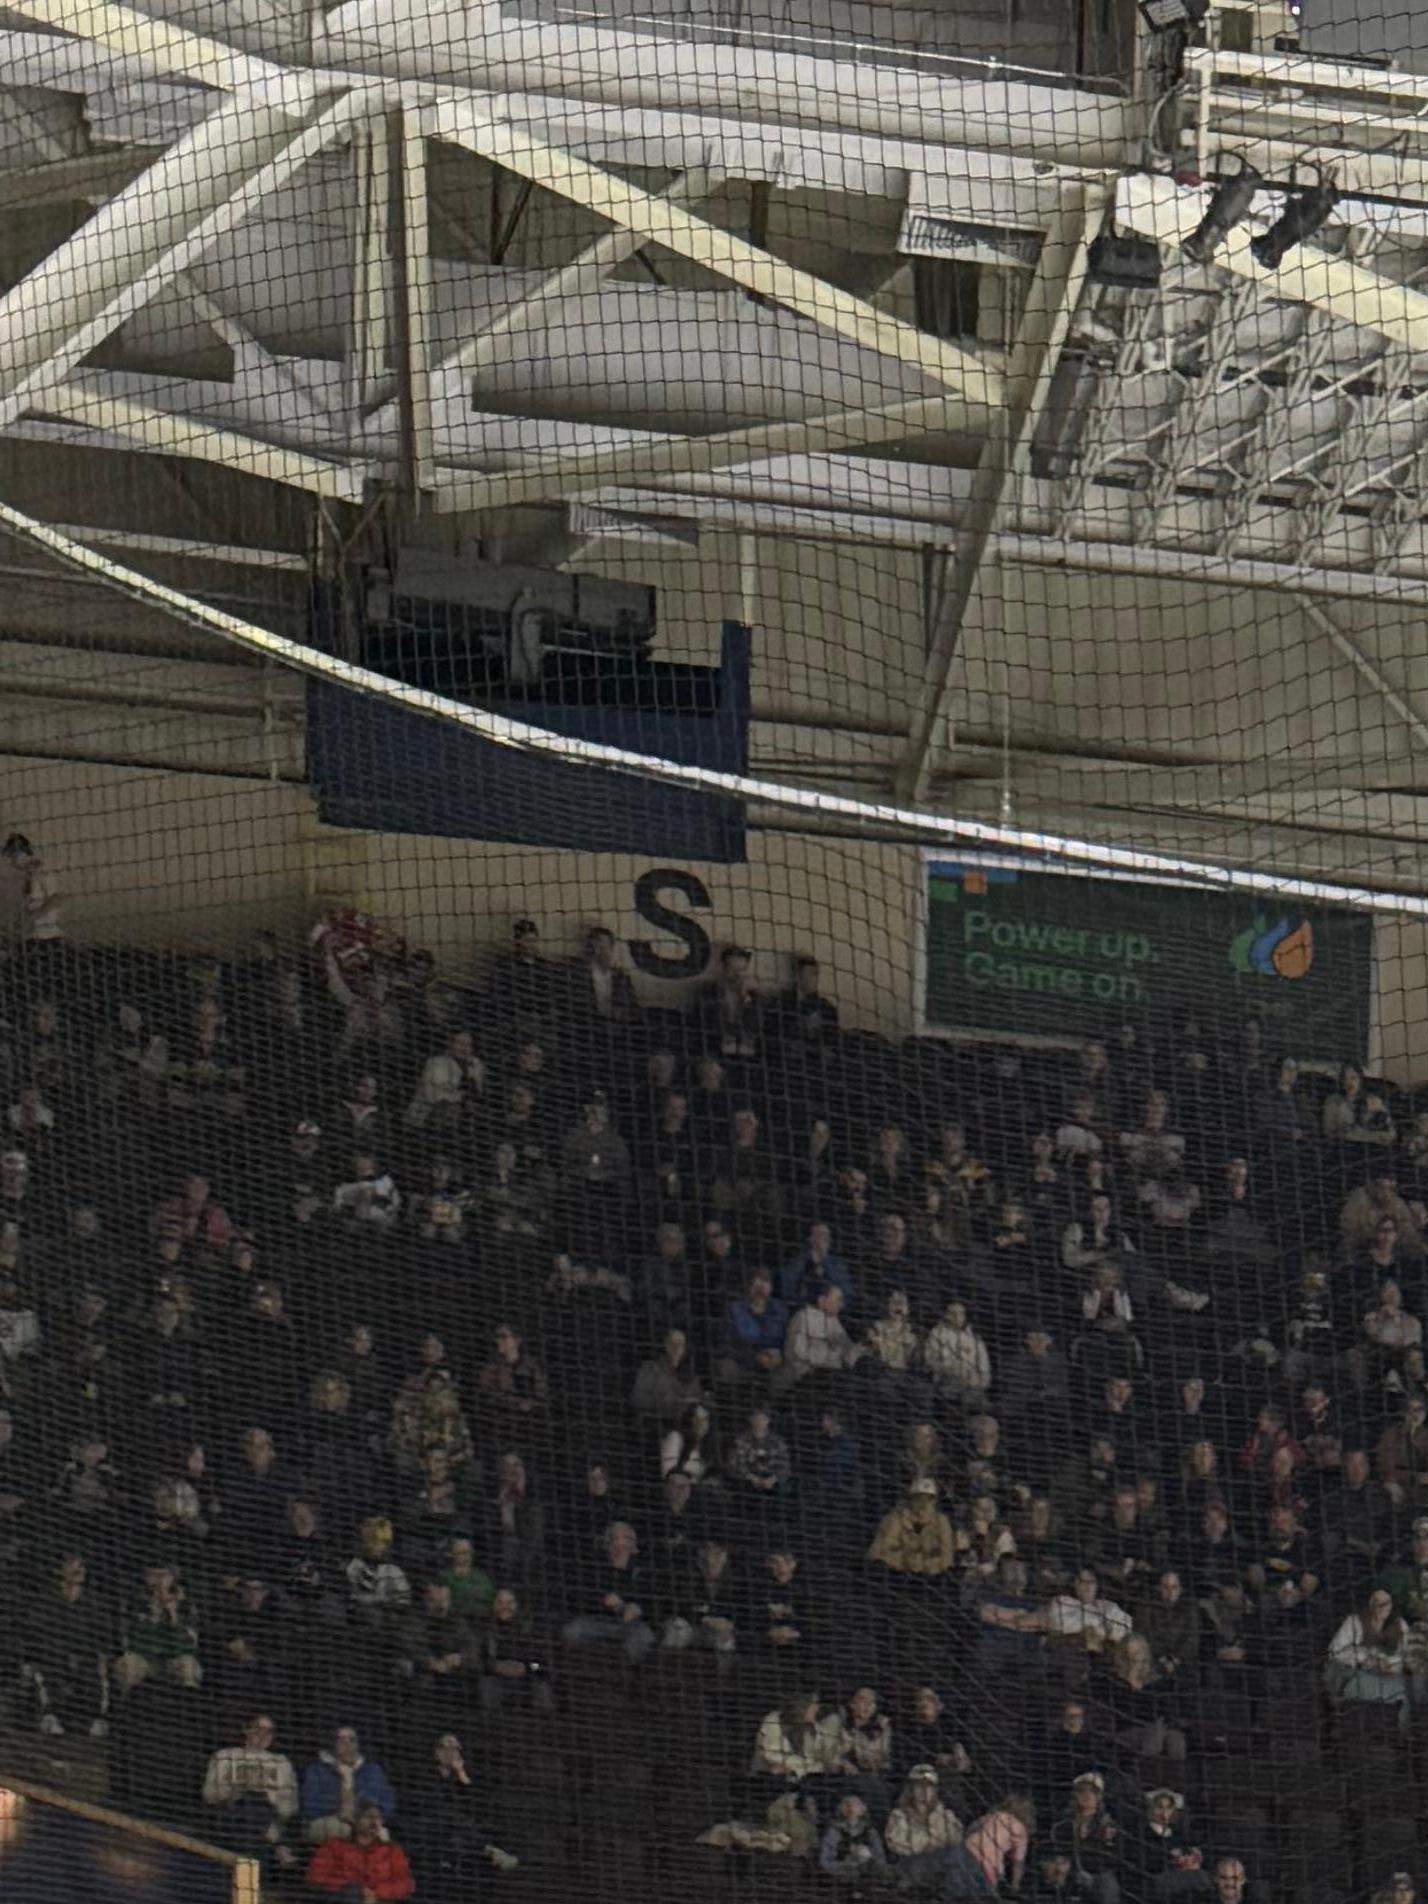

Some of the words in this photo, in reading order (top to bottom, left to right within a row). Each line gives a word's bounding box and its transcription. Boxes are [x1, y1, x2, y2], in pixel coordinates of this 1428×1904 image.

[628, 867, 713, 980] S
[963, 910, 1088, 952] Power
[964, 950, 1083, 992] Game
